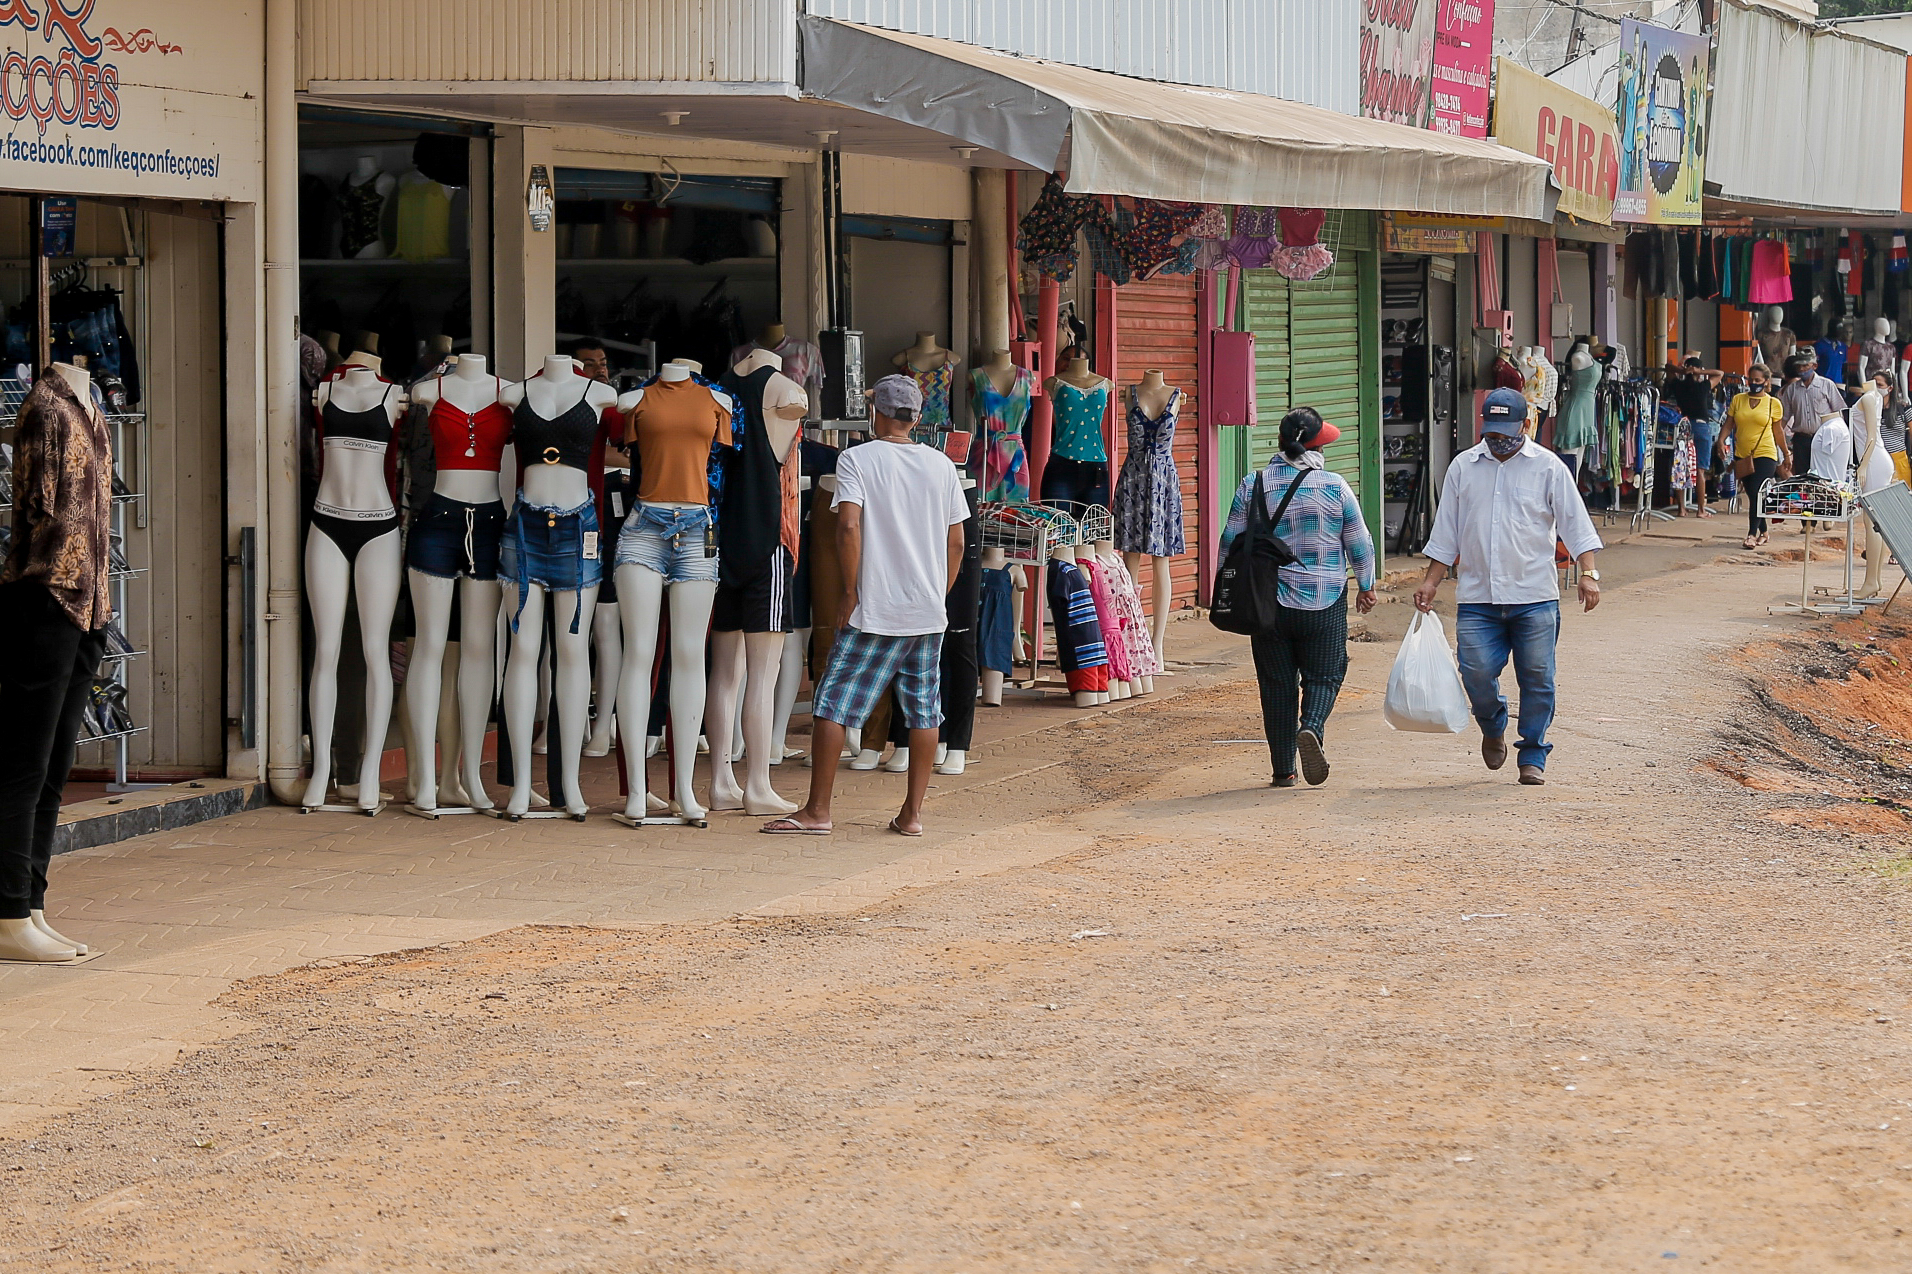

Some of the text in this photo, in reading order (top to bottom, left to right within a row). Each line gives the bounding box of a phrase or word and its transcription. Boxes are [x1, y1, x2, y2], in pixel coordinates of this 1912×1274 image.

[0, 47, 120, 136] CÇÕES
[0, 132, 220, 180] .facebook.com/keqconfecçoes/
[343, 440, 379, 451] Calvin Klein
[322, 506, 340, 516] Klein
